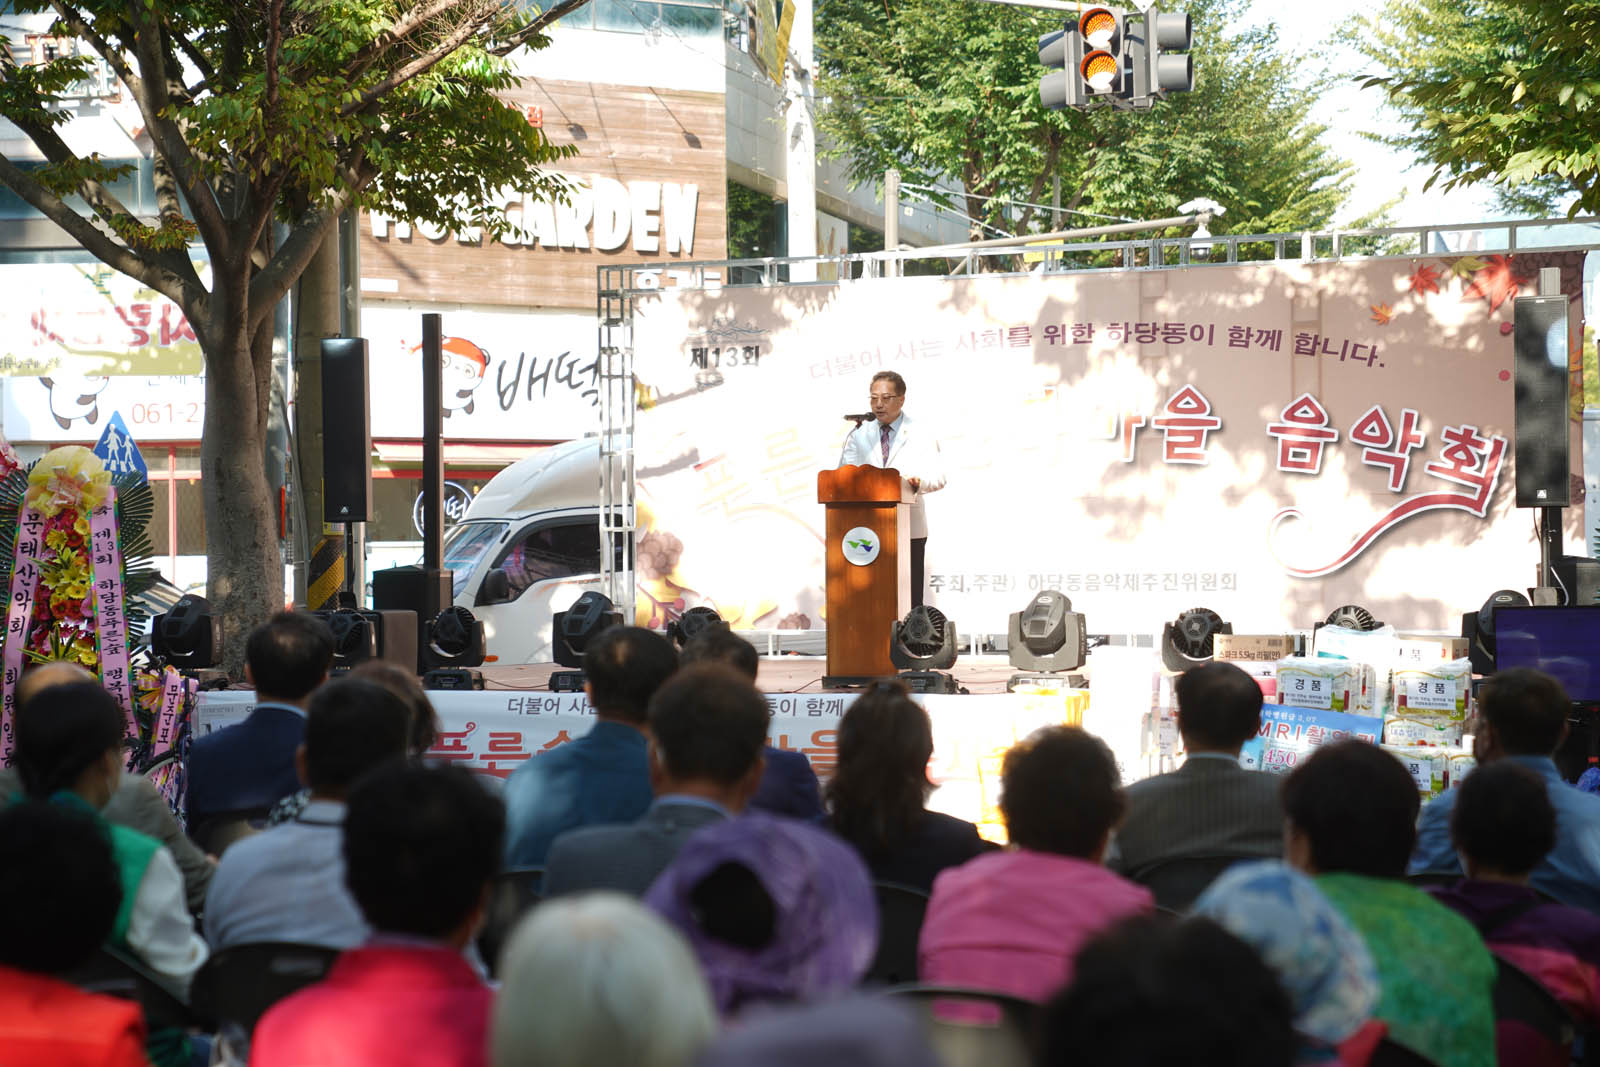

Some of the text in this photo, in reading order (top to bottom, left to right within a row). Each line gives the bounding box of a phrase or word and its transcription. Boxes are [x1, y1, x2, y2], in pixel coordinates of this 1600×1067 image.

[690, 345, 760, 369] 제13회
[808, 322, 1386, 381] 더불어 사는 사회를 위한 하당동이 함께 합니다.
[132, 401, 207, 424] 061-2
[1267, 393, 1507, 517] 음악회
[10, 513, 44, 637] 문태산악회
[1028, 572, 1238, 592] 하당동음악제추진위원회
[507, 697, 560, 715] 더불어
[806, 698, 844, 717] 함께
[1259, 721, 1301, 741] MRI
[1264, 748, 1297, 767] 450
